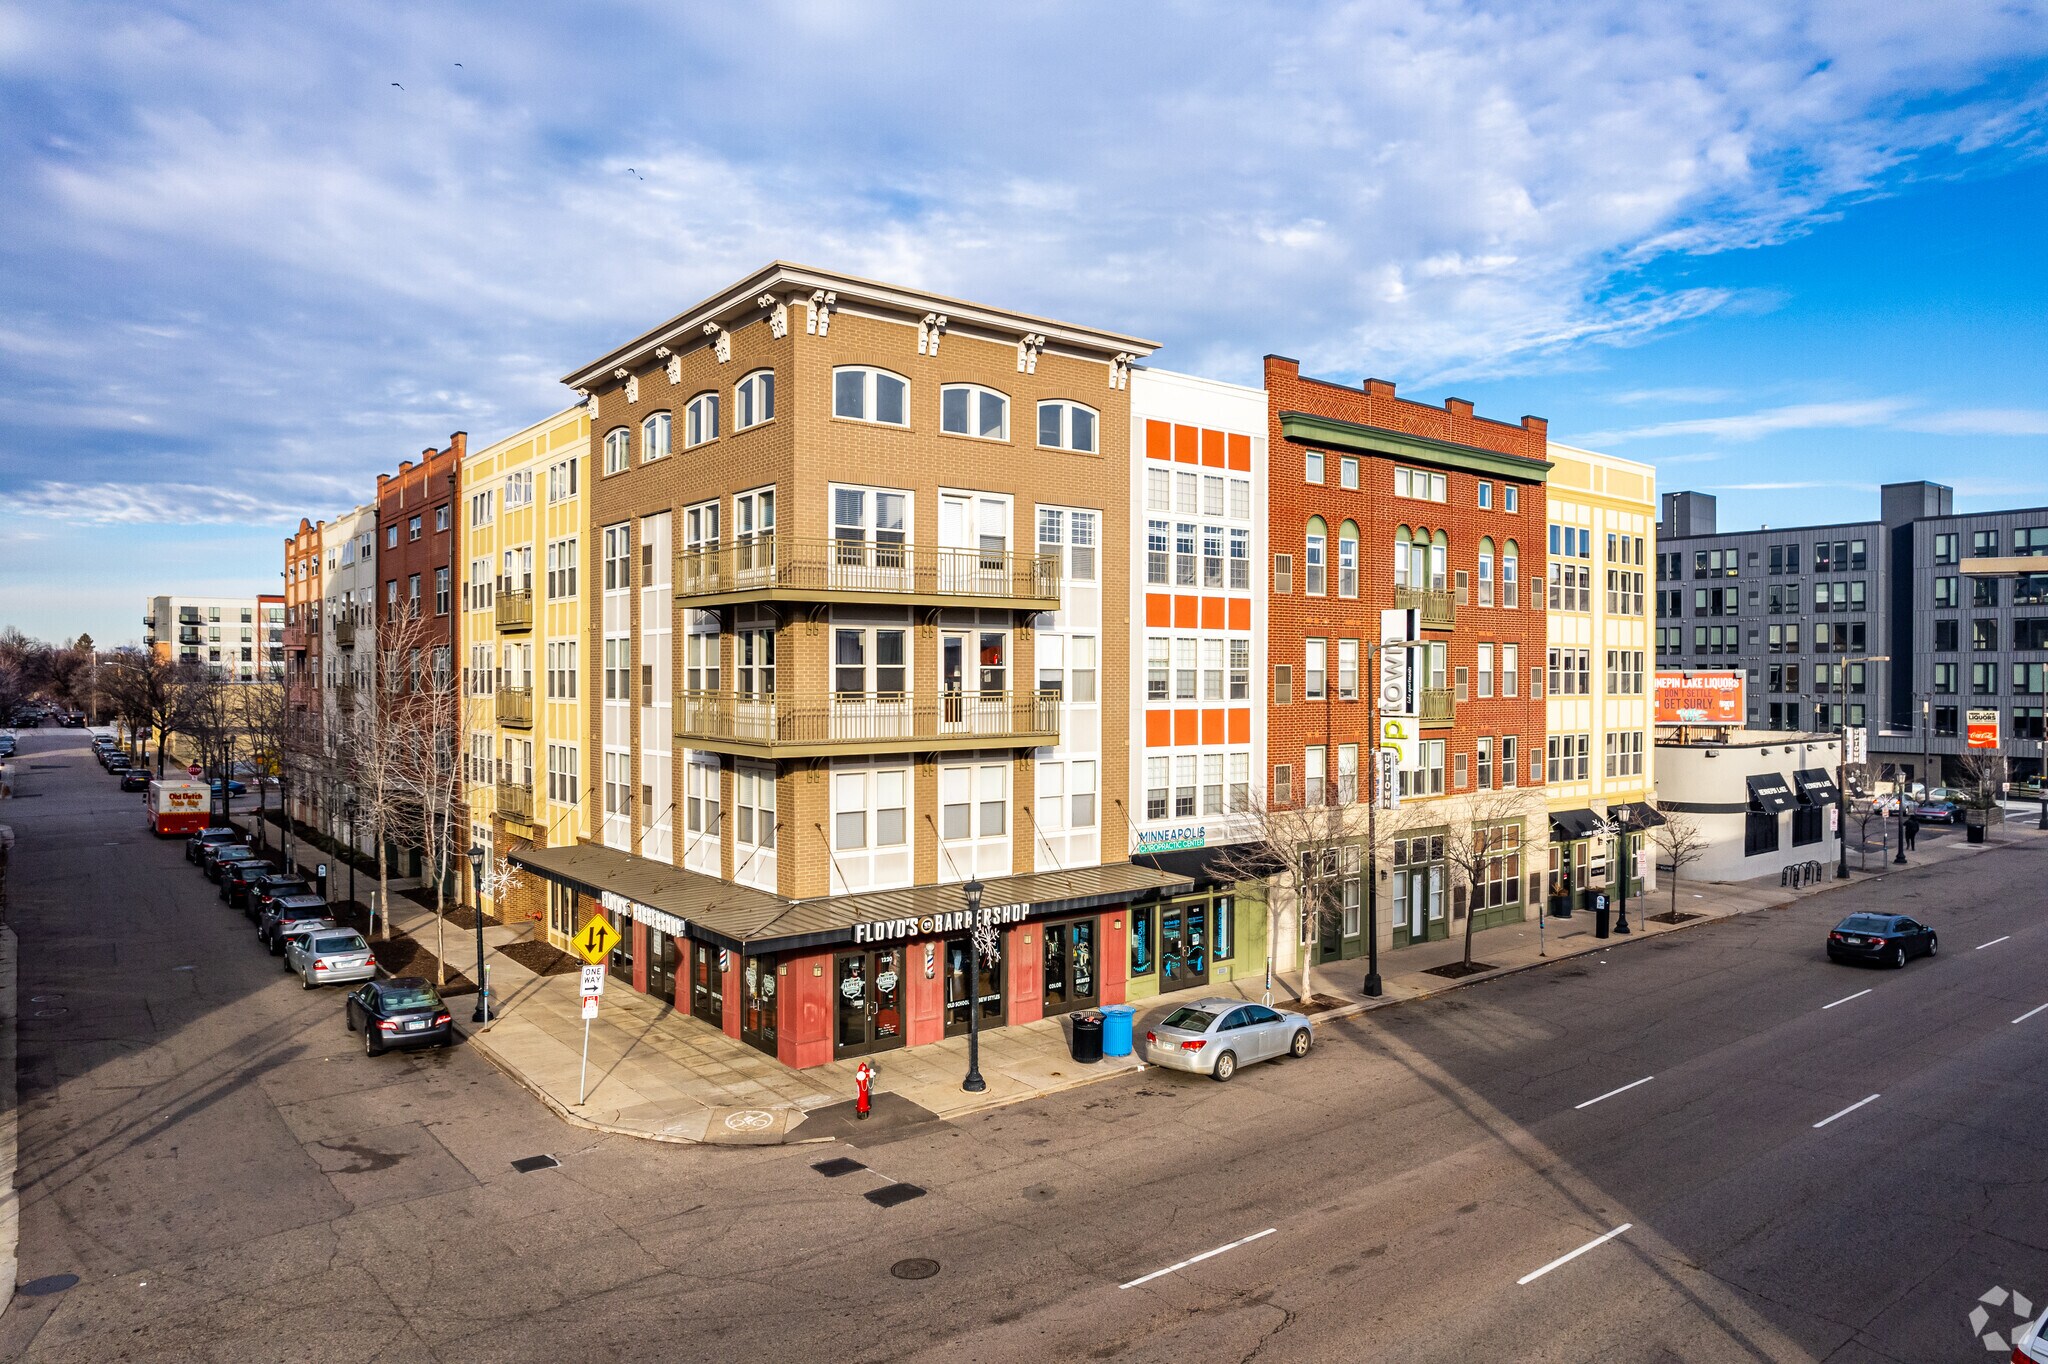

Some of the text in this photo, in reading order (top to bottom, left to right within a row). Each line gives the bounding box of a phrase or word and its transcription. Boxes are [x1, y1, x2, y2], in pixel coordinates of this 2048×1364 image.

[1682, 677, 1703, 688] LAKE
[1704, 677, 1740, 690] LIQUORS
[1664, 698, 1681, 709] GET
[1684, 698, 1715, 710] SURLY.
[1139, 826, 1206, 842] MINNEAPOLIS
[1140, 838, 1204, 853] CHIROPRACTIC CENTER
[854, 917, 919, 944] FLOYD'S
[933, 903, 1030, 933] BARBERSHOP
[585, 967, 602, 975] ONE
[584, 976, 601, 984] WAY
[1048, 982, 1062, 990] COLOR
